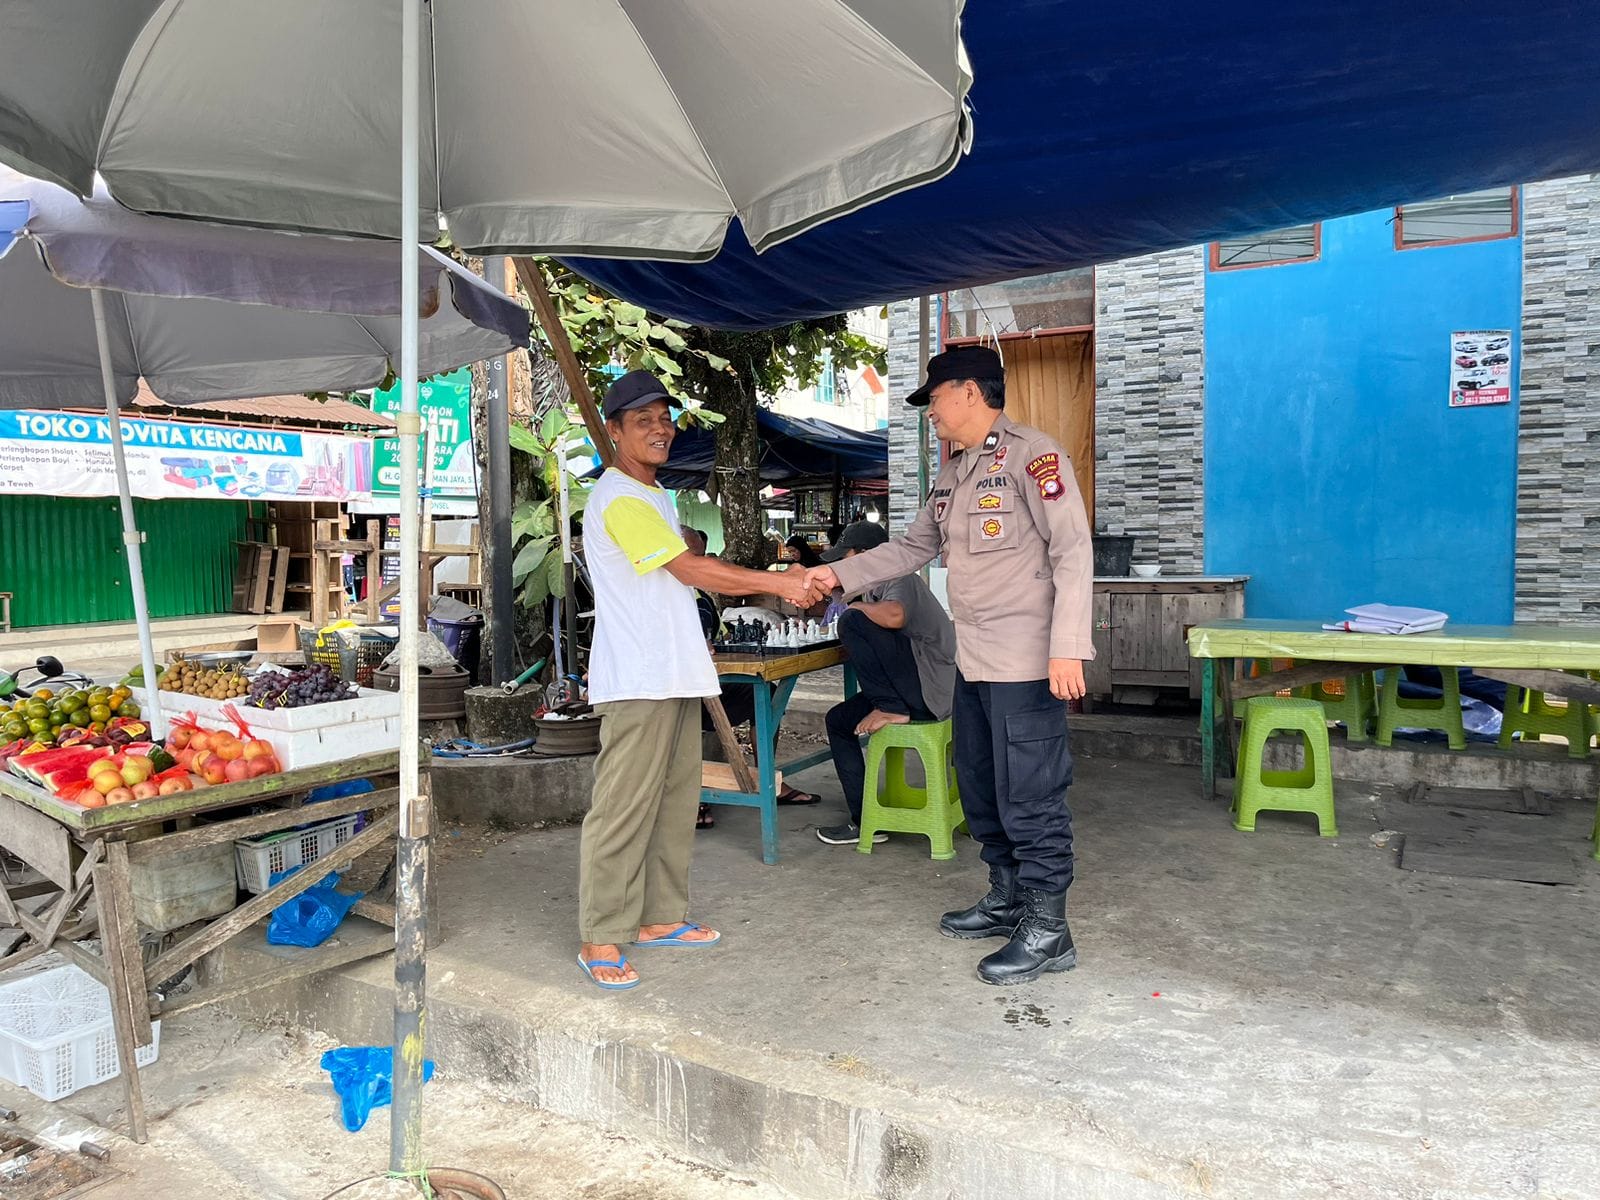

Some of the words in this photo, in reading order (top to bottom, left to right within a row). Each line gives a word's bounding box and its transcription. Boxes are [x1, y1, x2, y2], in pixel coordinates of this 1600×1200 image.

[16, 414, 90, 439] TOKO
[97, 420, 187, 446] NOVITA
[191, 430, 287, 453] KENCANA
[1, 445, 49, 454] erlengkapan
[976, 476, 1007, 490] POLRI
